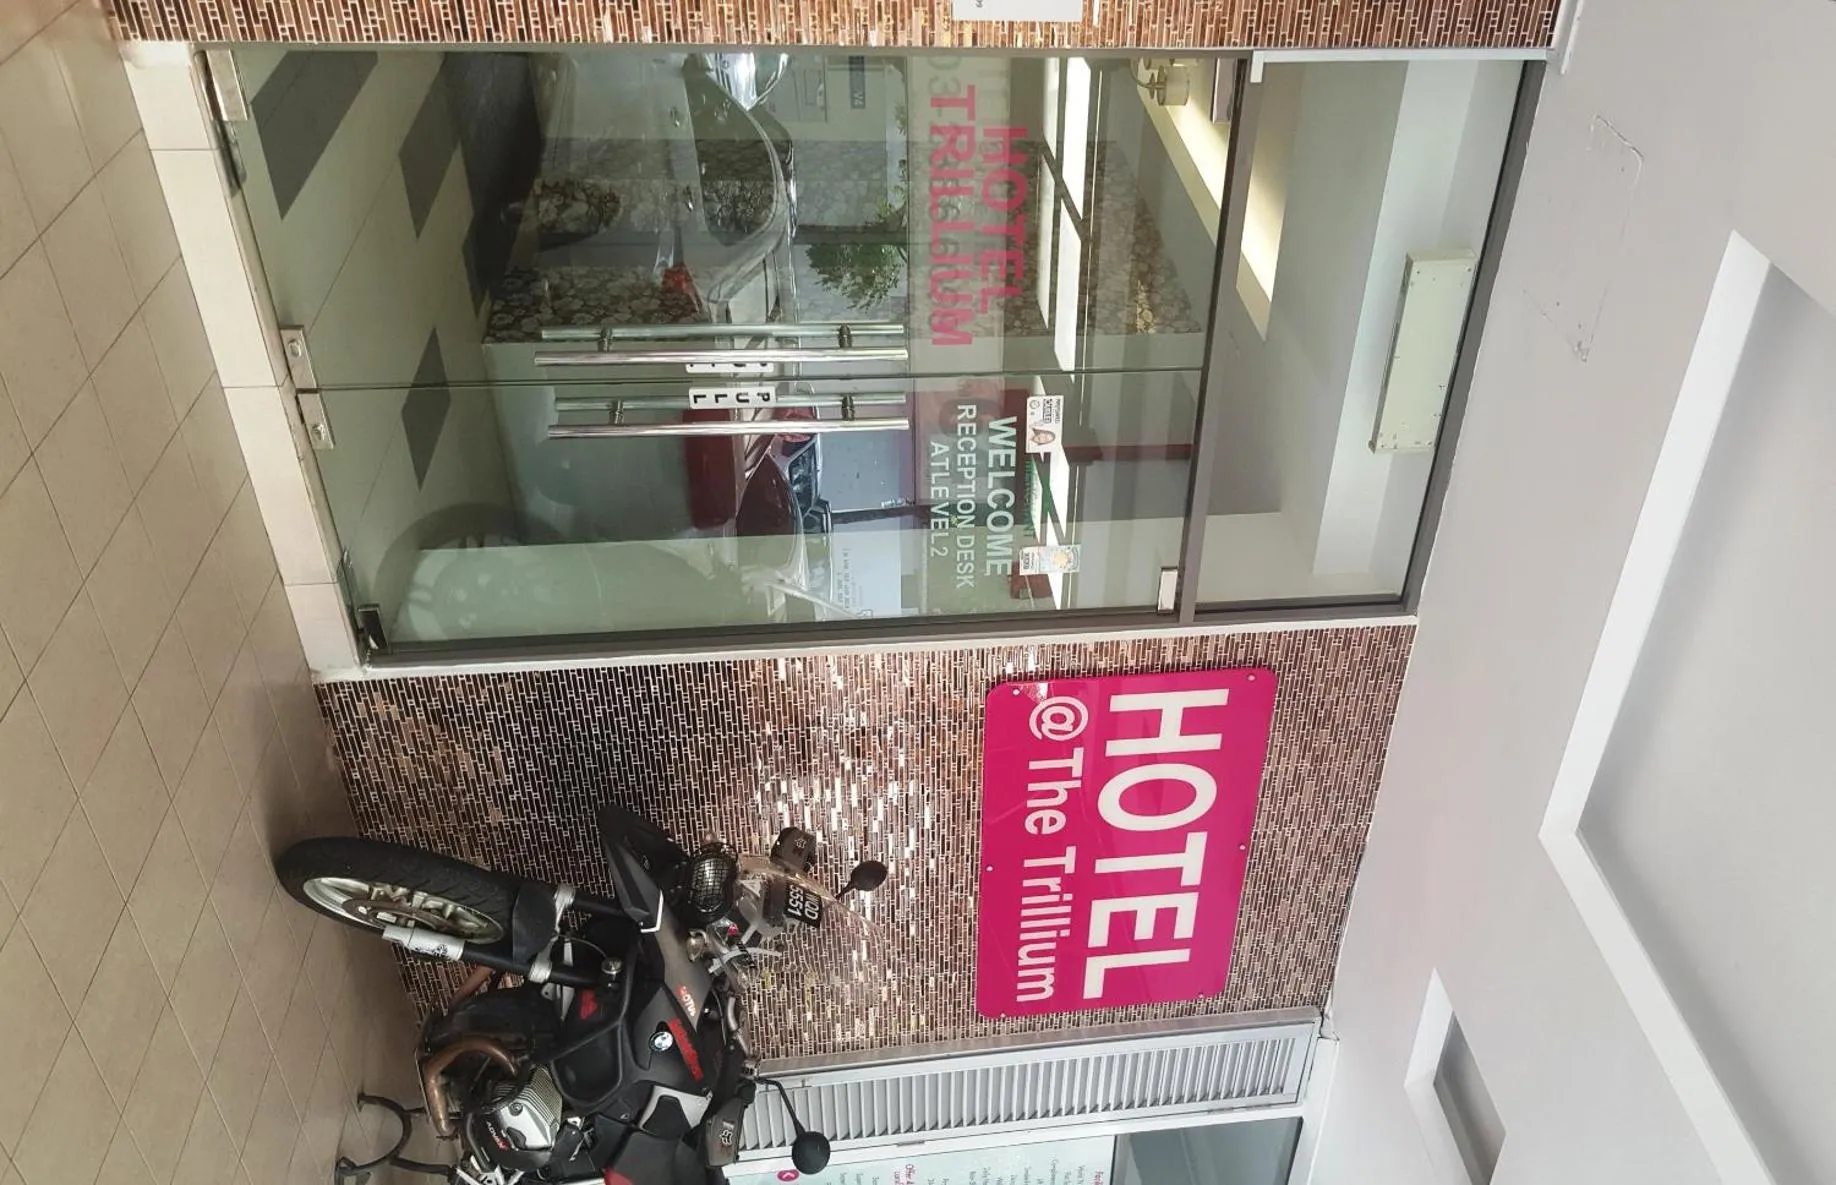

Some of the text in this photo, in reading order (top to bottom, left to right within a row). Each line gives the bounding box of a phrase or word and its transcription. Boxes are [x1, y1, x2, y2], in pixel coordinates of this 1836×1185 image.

[929, 84, 976, 346] TRILLIUM
[978, 126, 1028, 314] HOTEL
[693, 392, 770, 404] PULL
[956, 404, 976, 588] RECEPTION DESK
[986, 416, 1018, 576] WELCOME
[788, 884, 804, 917] 5551
[1016, 696, 1088, 1002] @ The Trillium
[1083, 688, 1230, 1000] HOTEL
